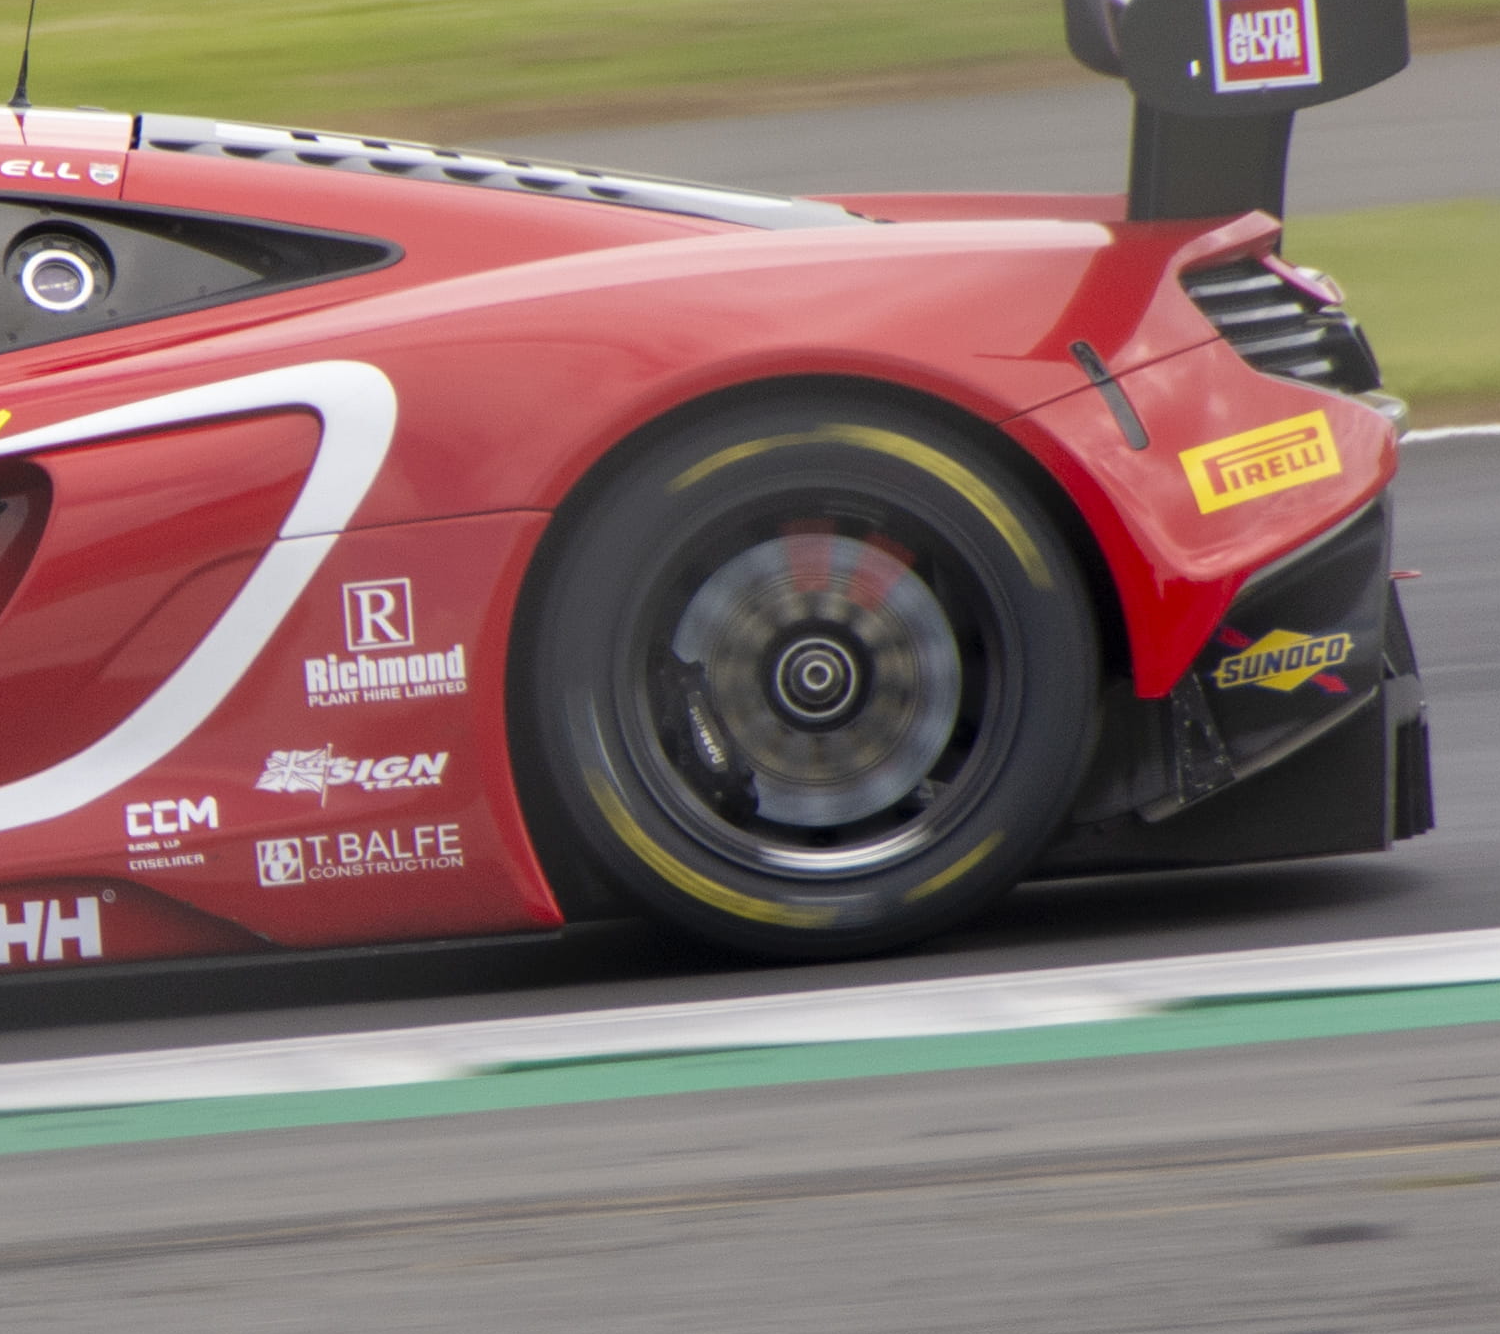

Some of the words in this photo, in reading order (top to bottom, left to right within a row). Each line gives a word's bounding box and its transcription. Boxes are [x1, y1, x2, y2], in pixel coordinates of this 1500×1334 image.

[1229, 8, 1299, 37] AUTO
[1229, 33, 1301, 64] GLYM
[1203, 427, 1326, 496] PIRELLI
[353, 588, 405, 644] R
[305, 644, 466, 692] Richmond
[1217, 637, 1346, 686] SUNOCO
[309, 691, 359, 707] PLANT
[363, 688, 401, 702] HIRE
[406, 680, 467, 698] LIMITED
[326, 752, 449, 785] SIGN
[362, 777, 441, 790] TEAM
[126, 795, 218, 837] CCM
[306, 836, 332, 865] T.
[338, 824, 462, 863] BALFE
[309, 856, 464, 879] CONSTRUCTION
